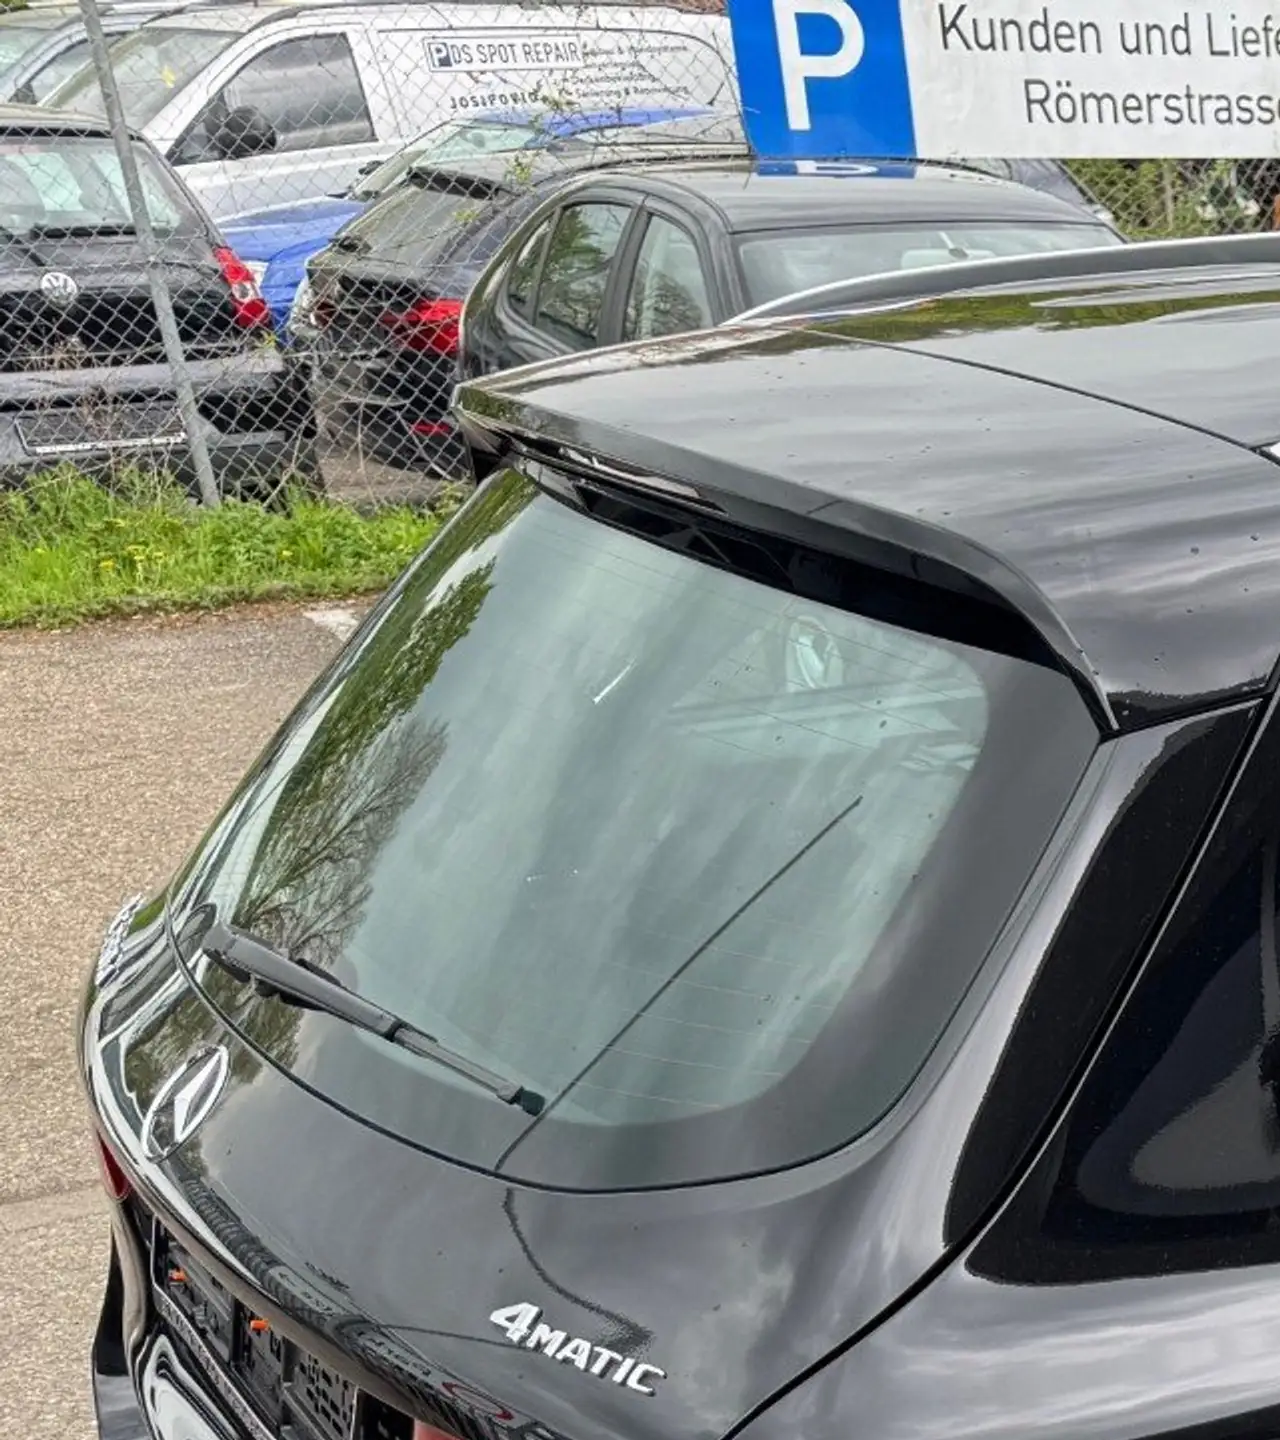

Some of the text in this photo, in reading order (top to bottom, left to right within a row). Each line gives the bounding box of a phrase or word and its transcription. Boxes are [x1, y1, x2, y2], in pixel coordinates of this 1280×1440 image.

[476, 43, 518, 64] SPOT
[522, 41, 580, 63] REPAIR
[772, 0, 865, 131] P
[938, 3, 1102, 54] Kunden
[1119, 11, 1192, 56] und
[489, 1301, 668, 1396] 4MATIC
